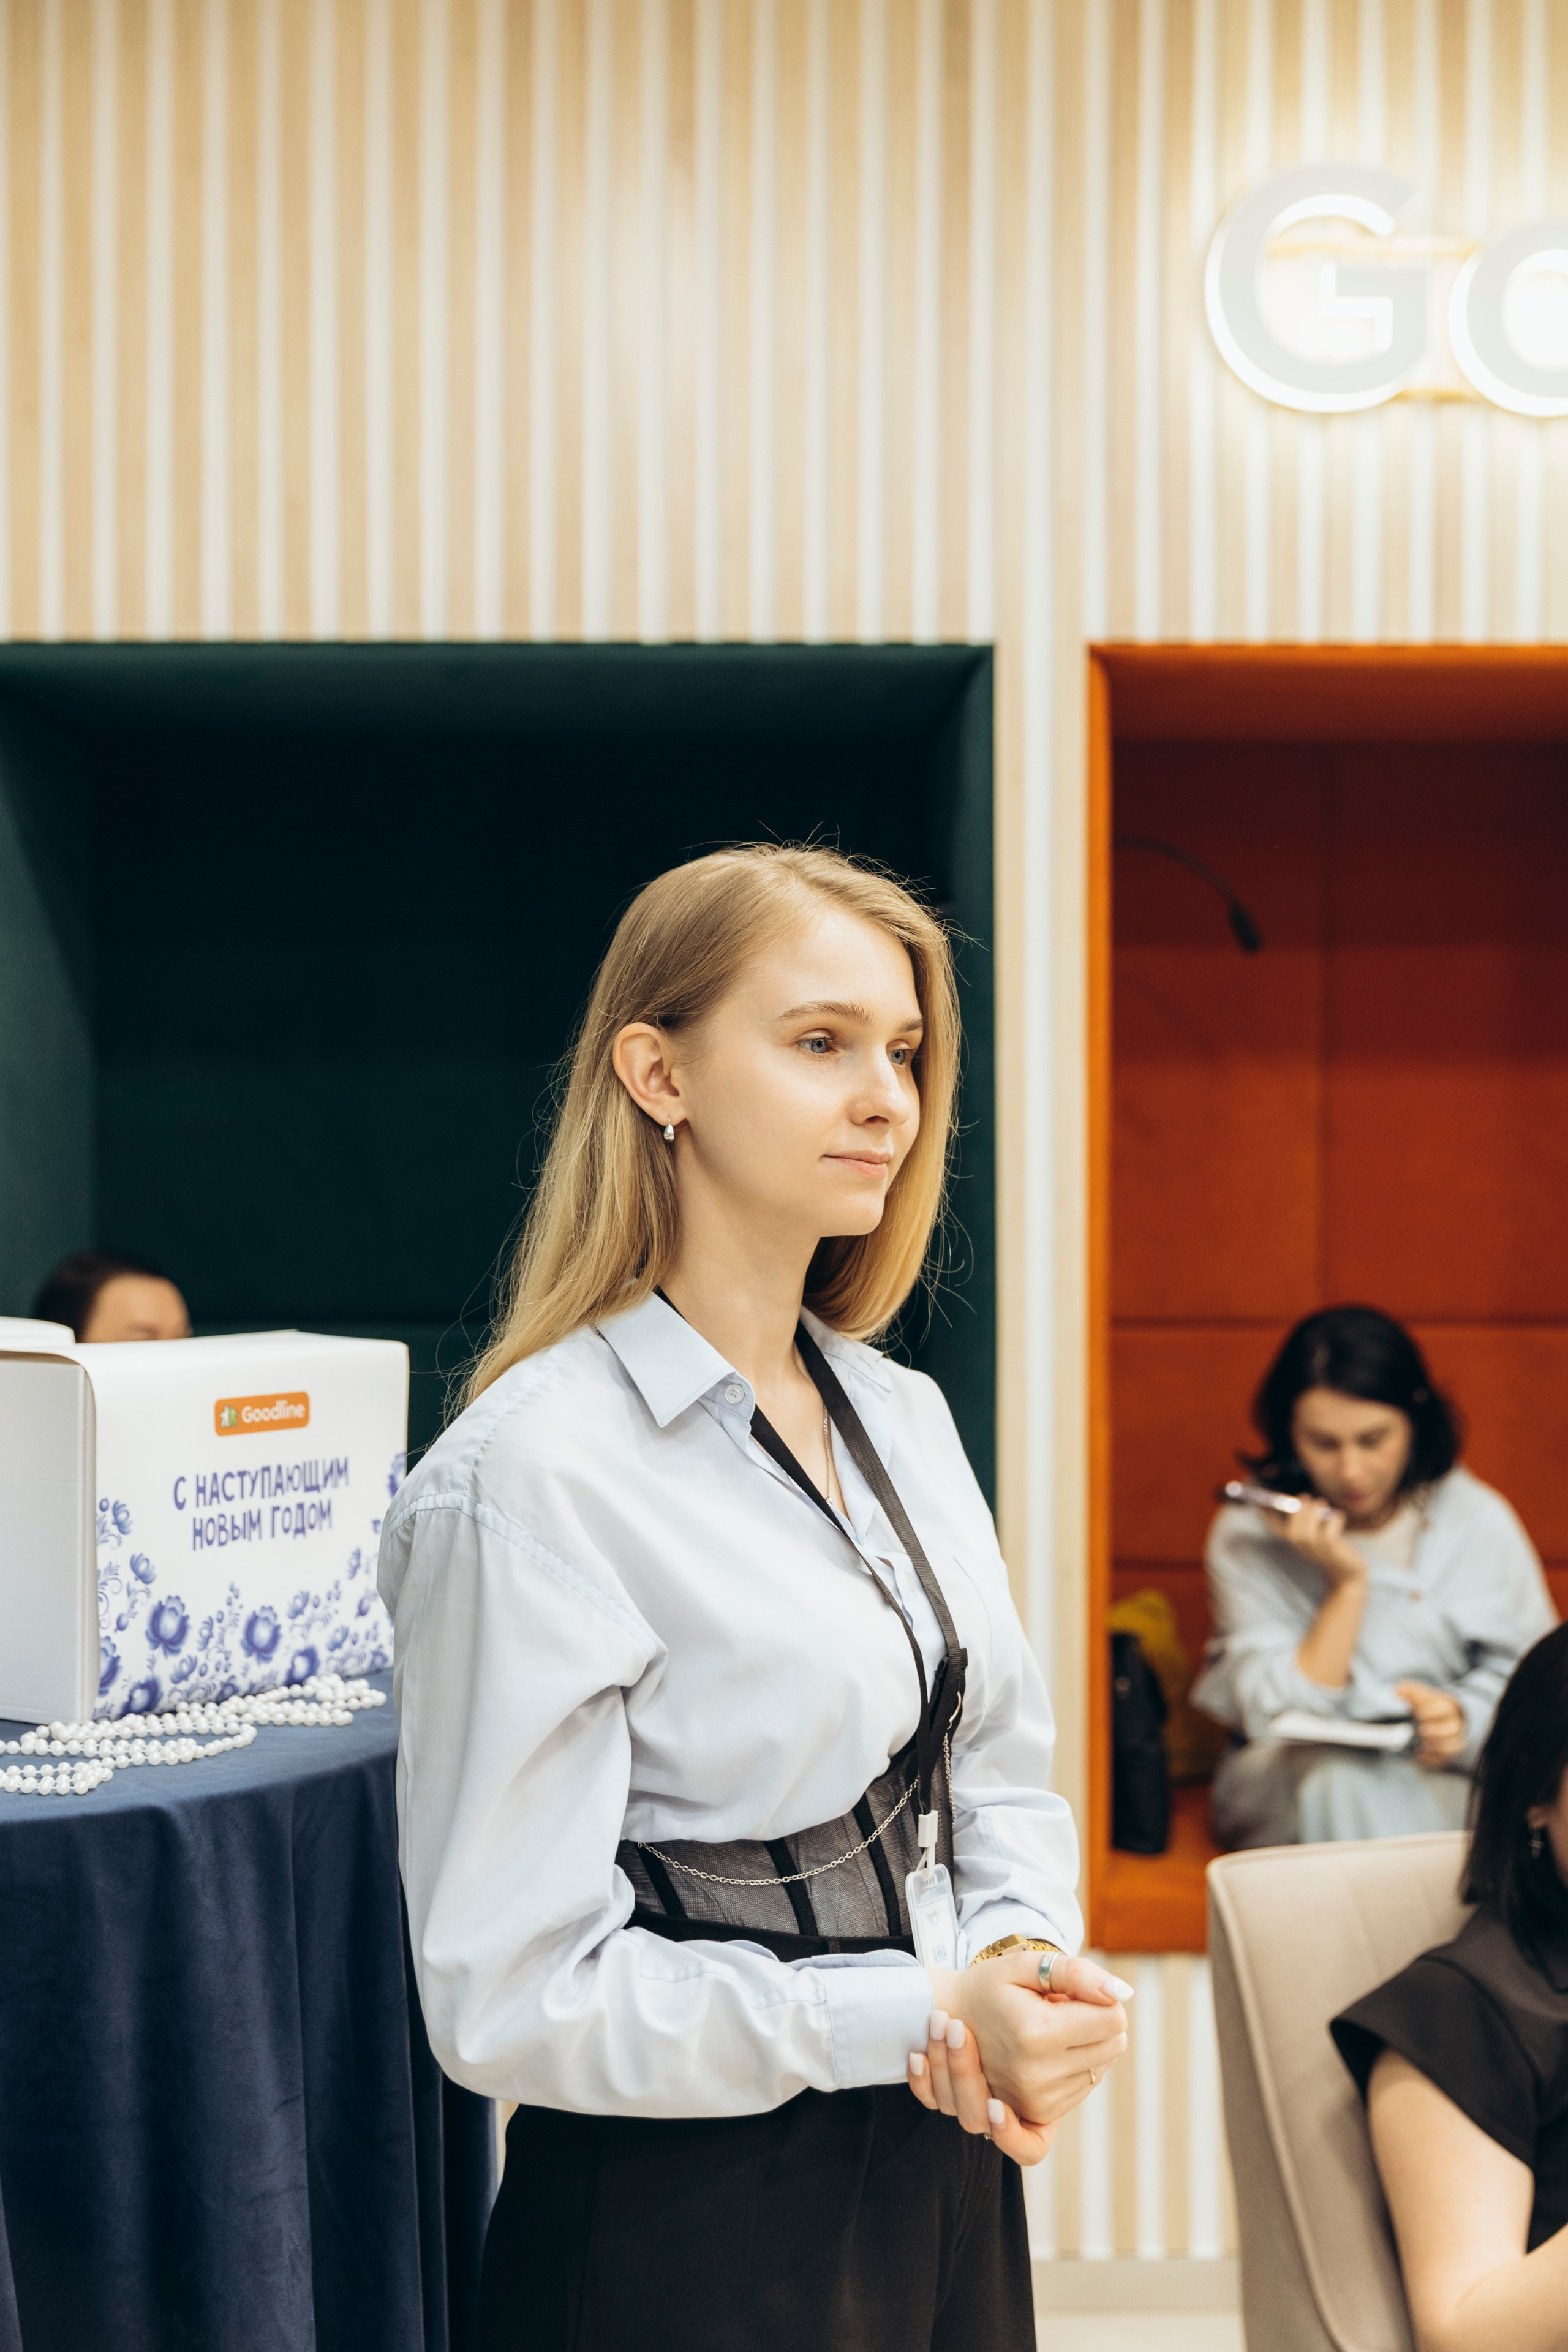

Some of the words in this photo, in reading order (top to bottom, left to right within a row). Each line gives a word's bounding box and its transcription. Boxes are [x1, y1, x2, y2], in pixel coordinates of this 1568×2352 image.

[241, 1400, 306, 1423] Goodline
[173, 1476, 186, 1510] С
[195, 1457, 349, 1508] НАСТУПАЮЩИМ
[192, 1508, 262, 1551] НОВЫМ
[271, 1499, 332, 1539] ГОДОМ
